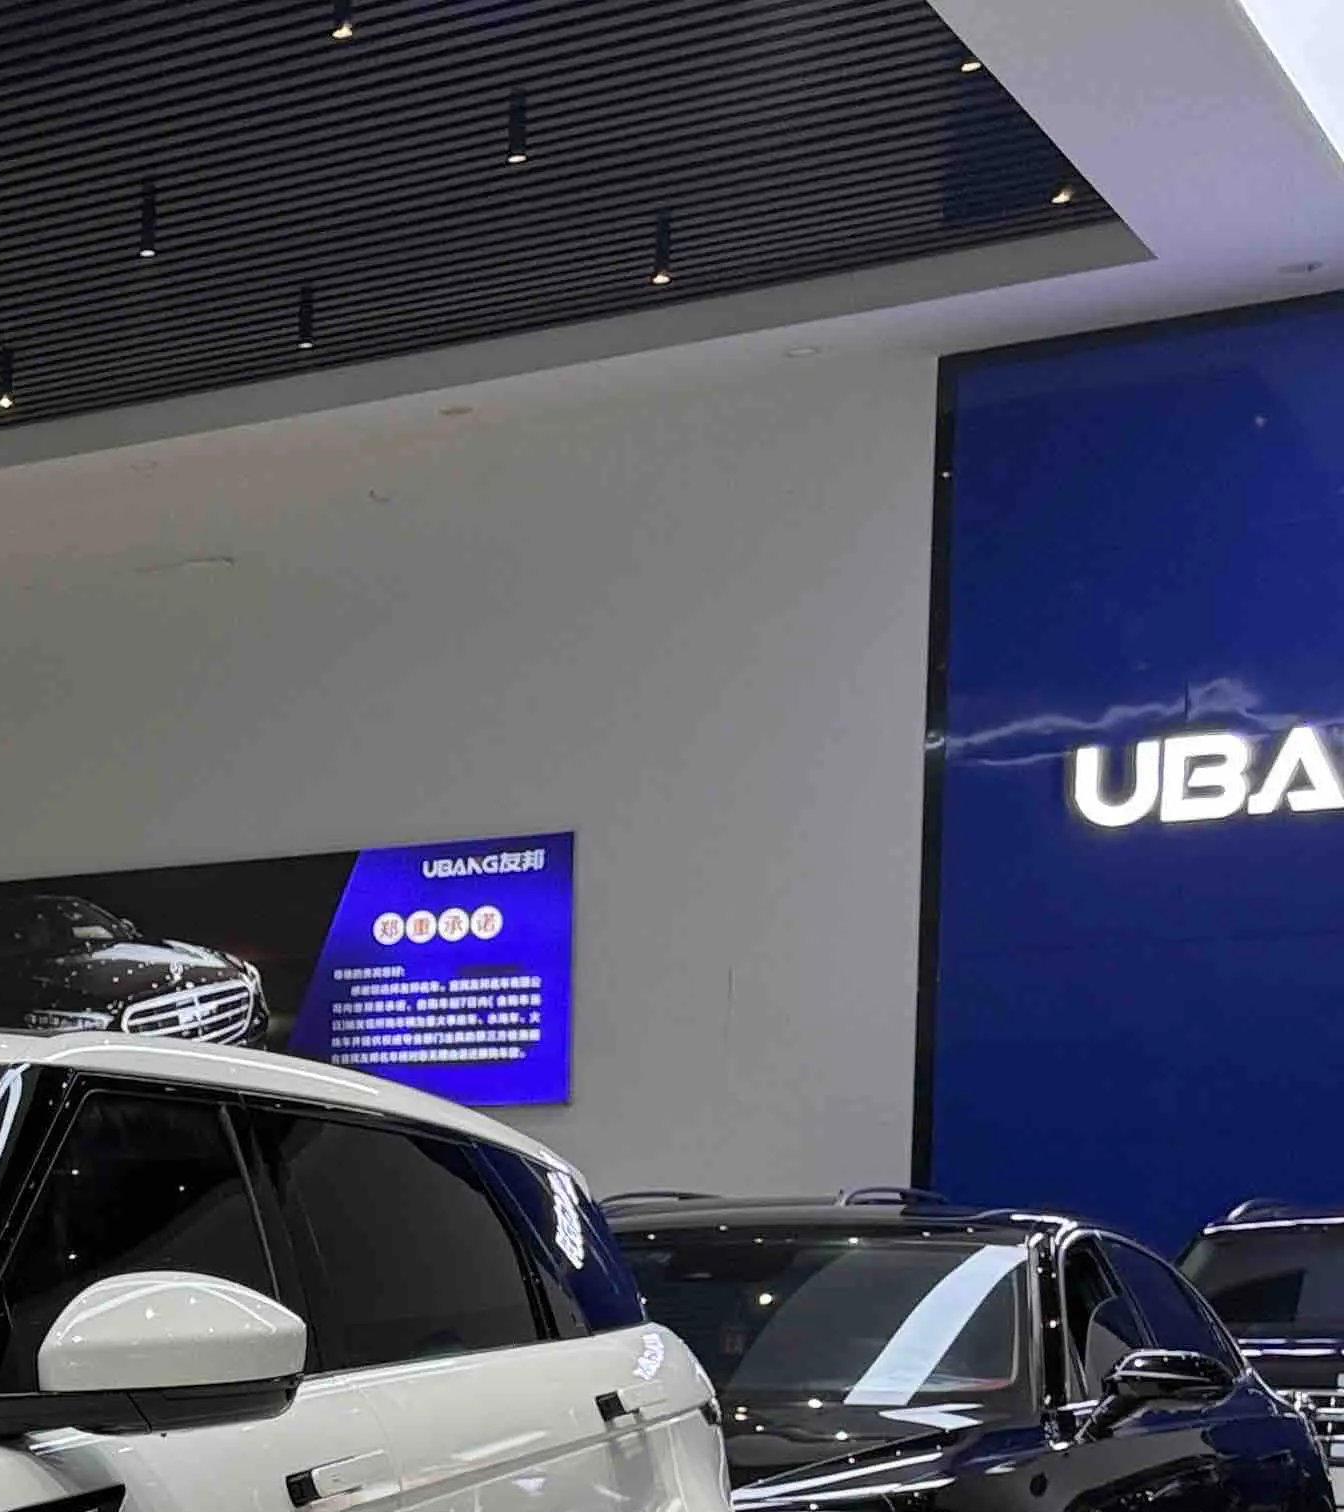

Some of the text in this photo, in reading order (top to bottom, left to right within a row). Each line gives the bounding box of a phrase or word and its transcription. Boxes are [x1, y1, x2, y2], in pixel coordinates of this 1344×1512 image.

[1073, 725, 1344, 827] UBA
[422, 849, 545, 879] UBANG友邦
[378, 910, 499, 940] 郑重承诺
